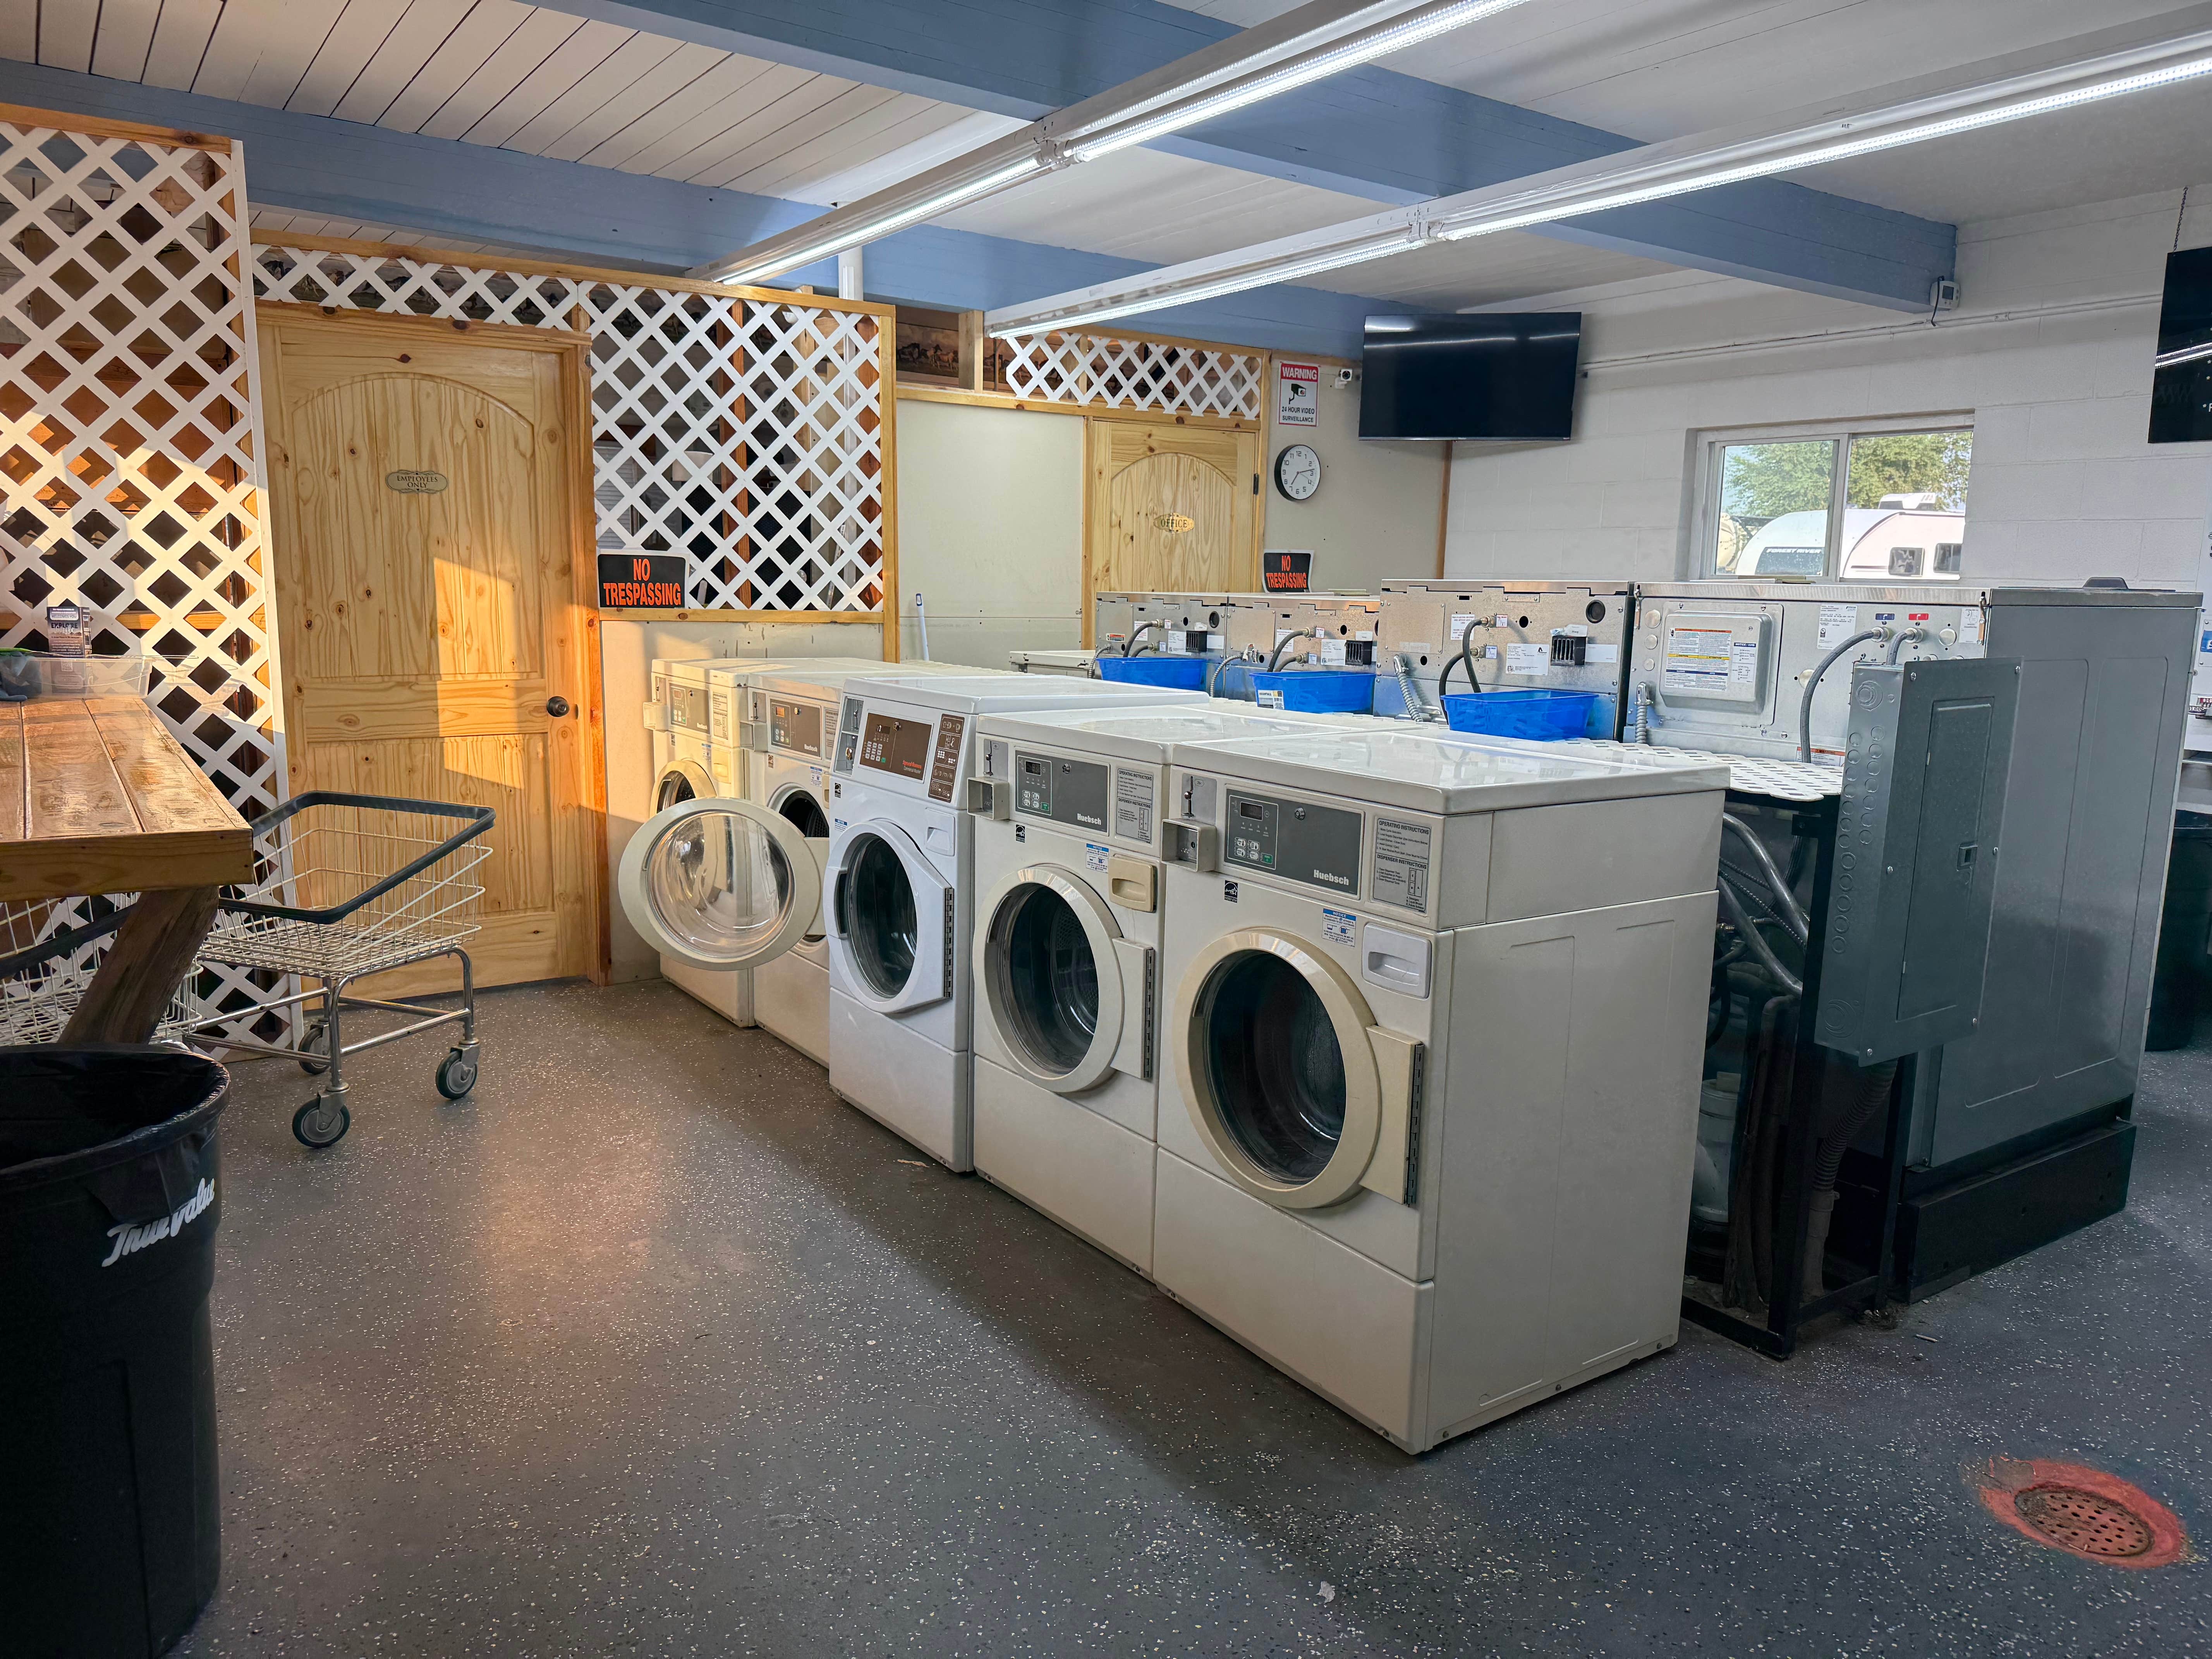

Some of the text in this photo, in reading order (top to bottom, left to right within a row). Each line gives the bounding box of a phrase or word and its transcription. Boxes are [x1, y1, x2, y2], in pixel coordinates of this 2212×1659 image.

[1283, 367, 1317, 380] WARNING
[1161, 518, 1187, 527] OFFICE
[633, 558, 651, 581] NO
[1281, 555, 1291, 571] NO
[1266, 572, 1307, 588] TRESPASSING
[603, 582, 681, 606] TRESPASSING
[1077, 813, 1101, 825] Huebsch
[1379, 821, 1400, 829] OPERATING
[1401, 824, 1429, 835] INSTRUCTIONS
[1377, 854, 1427, 869] DISPENSER INSTRUCTIONS
[1314, 869, 1349, 886] Huebsch
[101, 1177, 215, 1267] True Value
